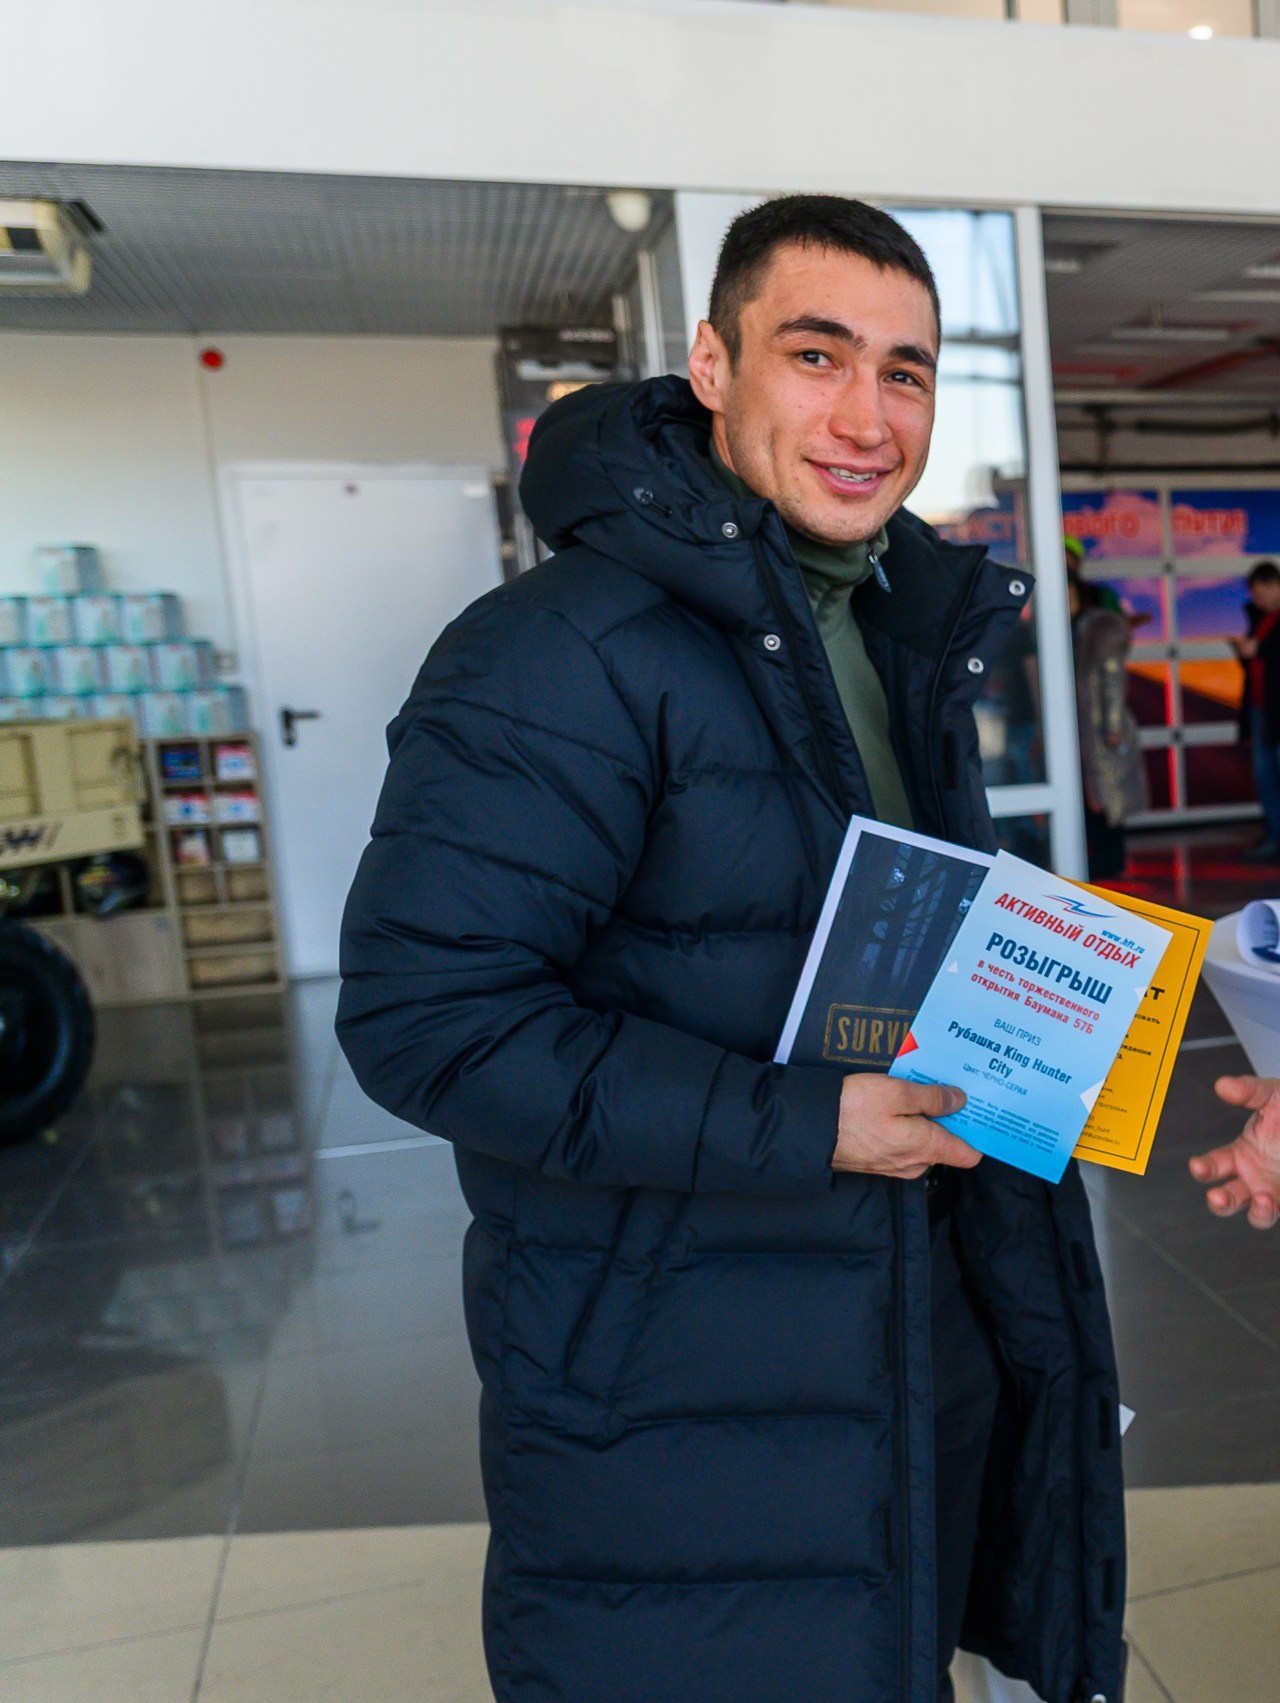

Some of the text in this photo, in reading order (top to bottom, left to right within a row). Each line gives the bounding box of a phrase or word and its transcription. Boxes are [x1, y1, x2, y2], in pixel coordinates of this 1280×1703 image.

[994, 893, 1141, 969] АКТИВНЫЙ ОТДЫХ
[985, 932, 1113, 1005] РОЗЫГРЫШ
[988, 963, 1015, 983] честь
[1018, 977, 1100, 1022] торжественного
[971, 973, 1021, 1002] открытия
[1024, 996, 1069, 1024] Баумана
[948, 1021, 1072, 1085] Рубашка King Hunter
[994, 1019, 1042, 1047] ВАШ ПРИЗ
[988, 1058, 1014, 1079] City
